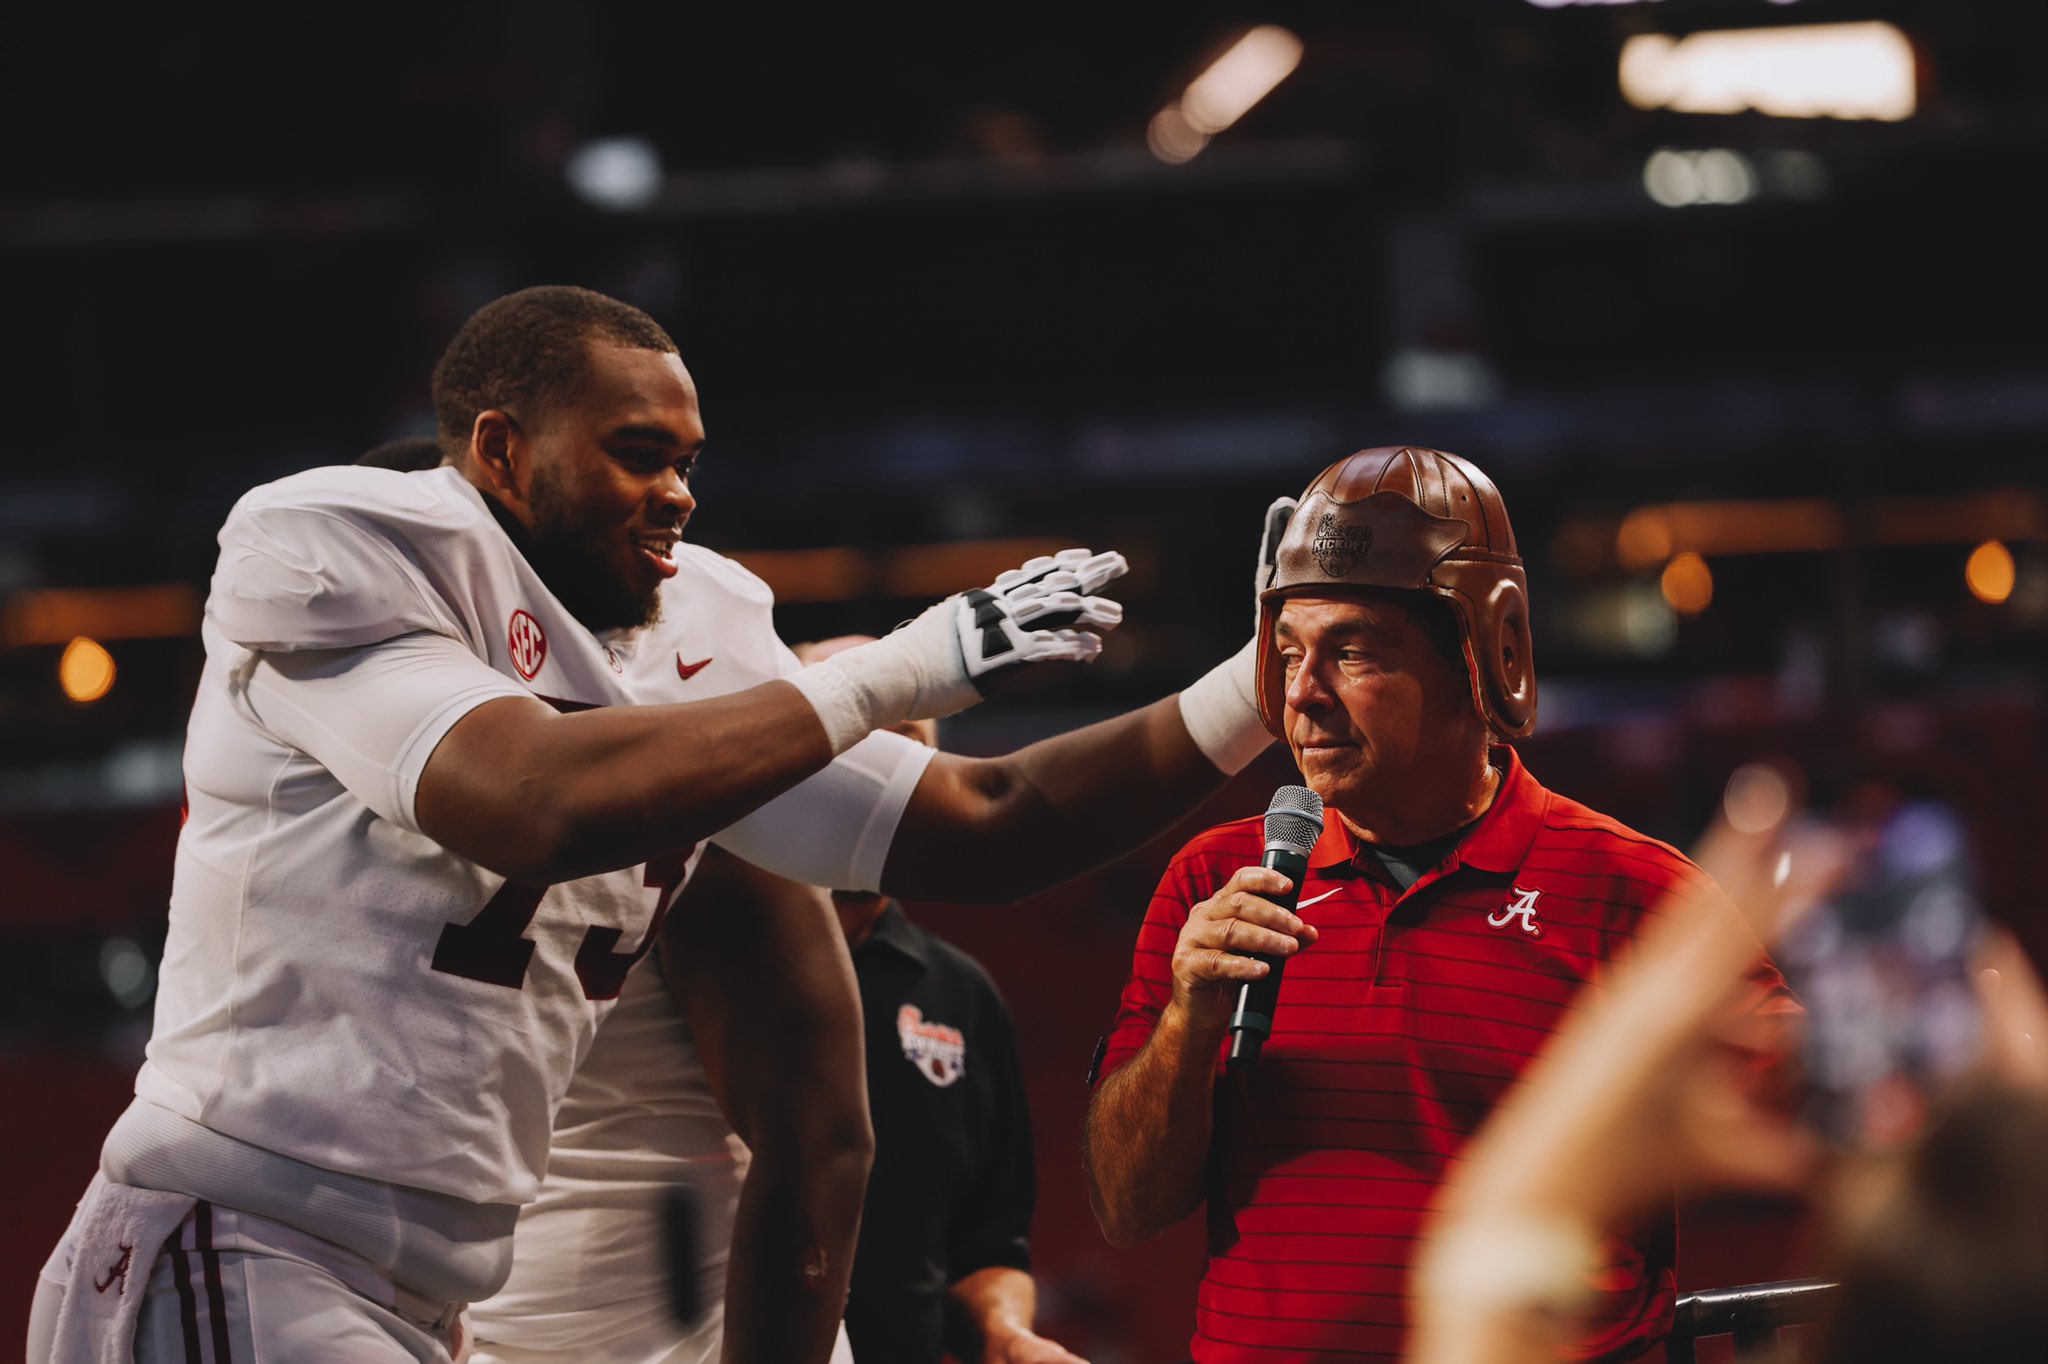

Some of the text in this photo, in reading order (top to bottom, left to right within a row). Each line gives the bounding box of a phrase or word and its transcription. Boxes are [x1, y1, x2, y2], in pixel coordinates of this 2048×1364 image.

[1313, 539, 1372, 553] KICKOFF
[510, 611, 543, 677] SEC
[1488, 887, 1541, 932] A
